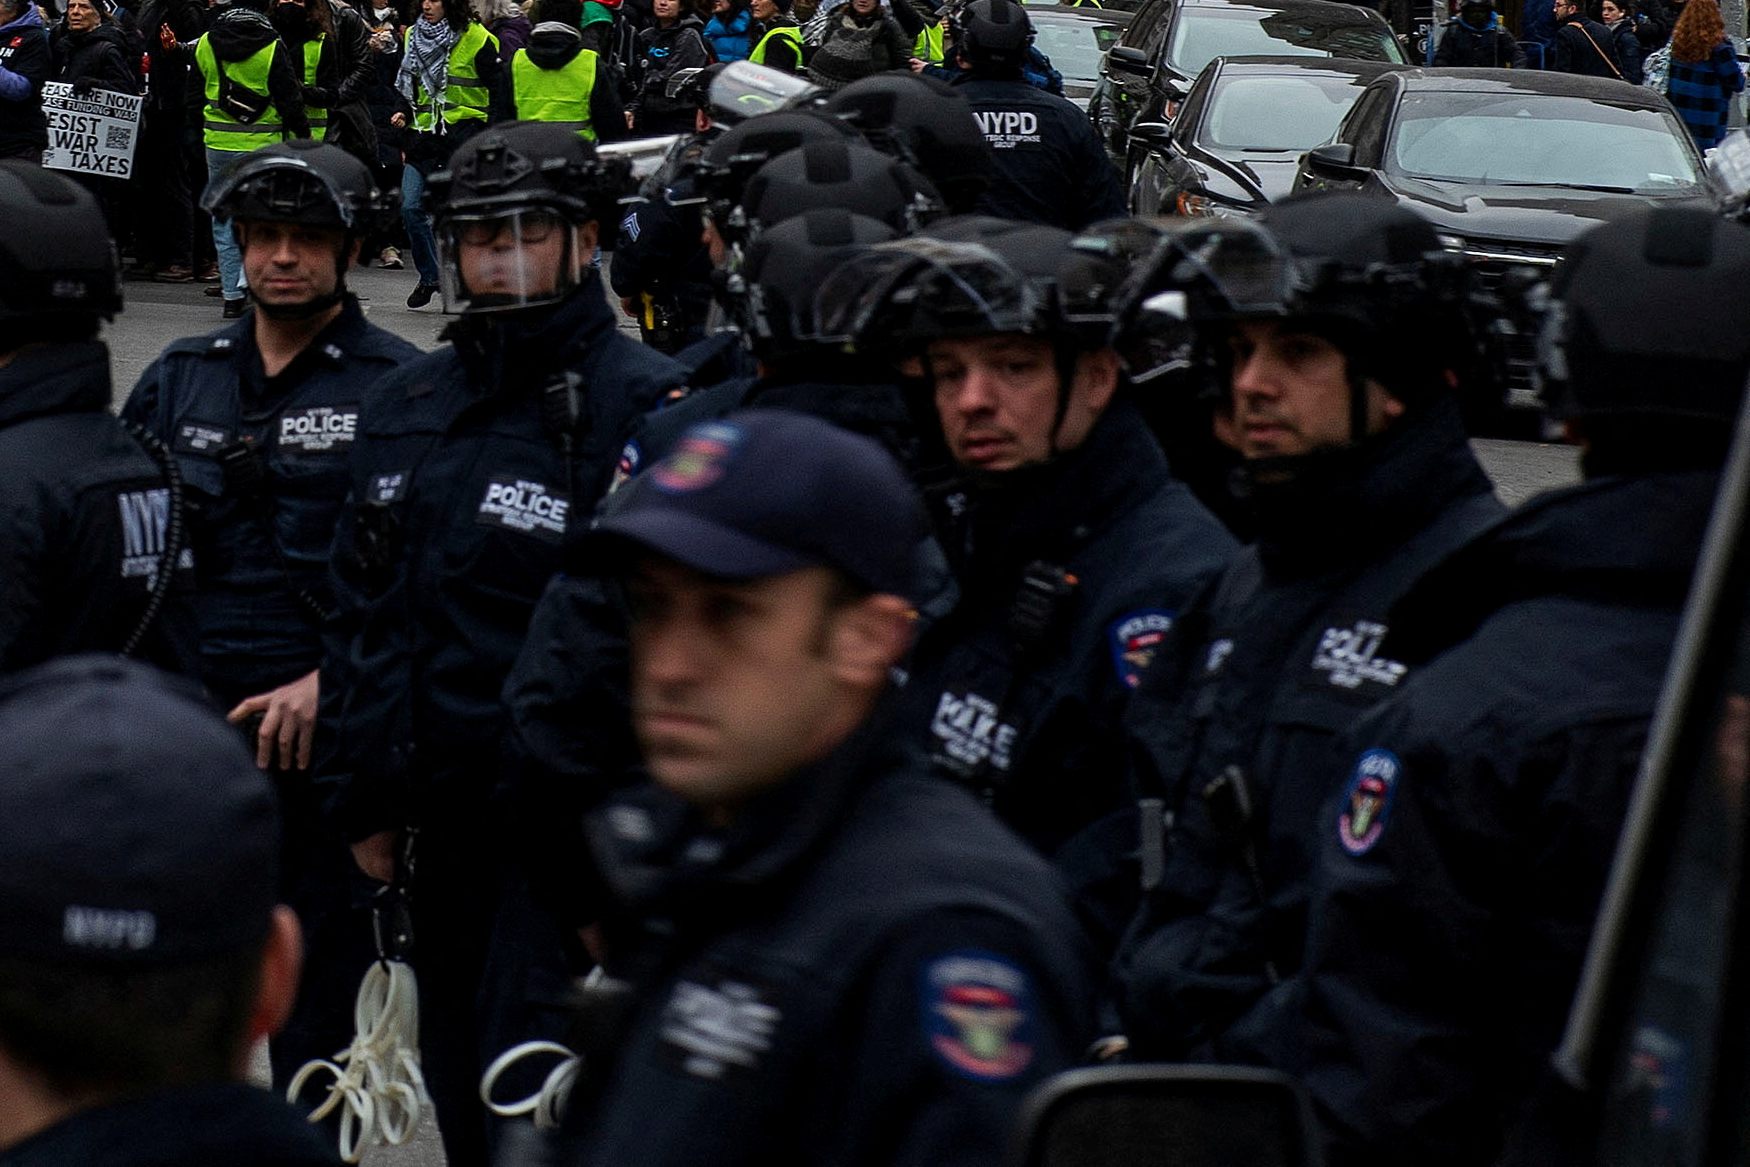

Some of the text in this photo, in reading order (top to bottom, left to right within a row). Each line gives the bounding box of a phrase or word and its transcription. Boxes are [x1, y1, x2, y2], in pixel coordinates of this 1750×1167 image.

[66, 101, 138, 121] FUNDING WAR
[106, 93, 140, 111] NOW
[972, 111, 1038, 135] NYPD
[55, 131, 99, 153] WAR
[70, 150, 130, 176] TAXES
[281, 413, 358, 435] POLICE
[483, 482, 569, 521] POLICE
